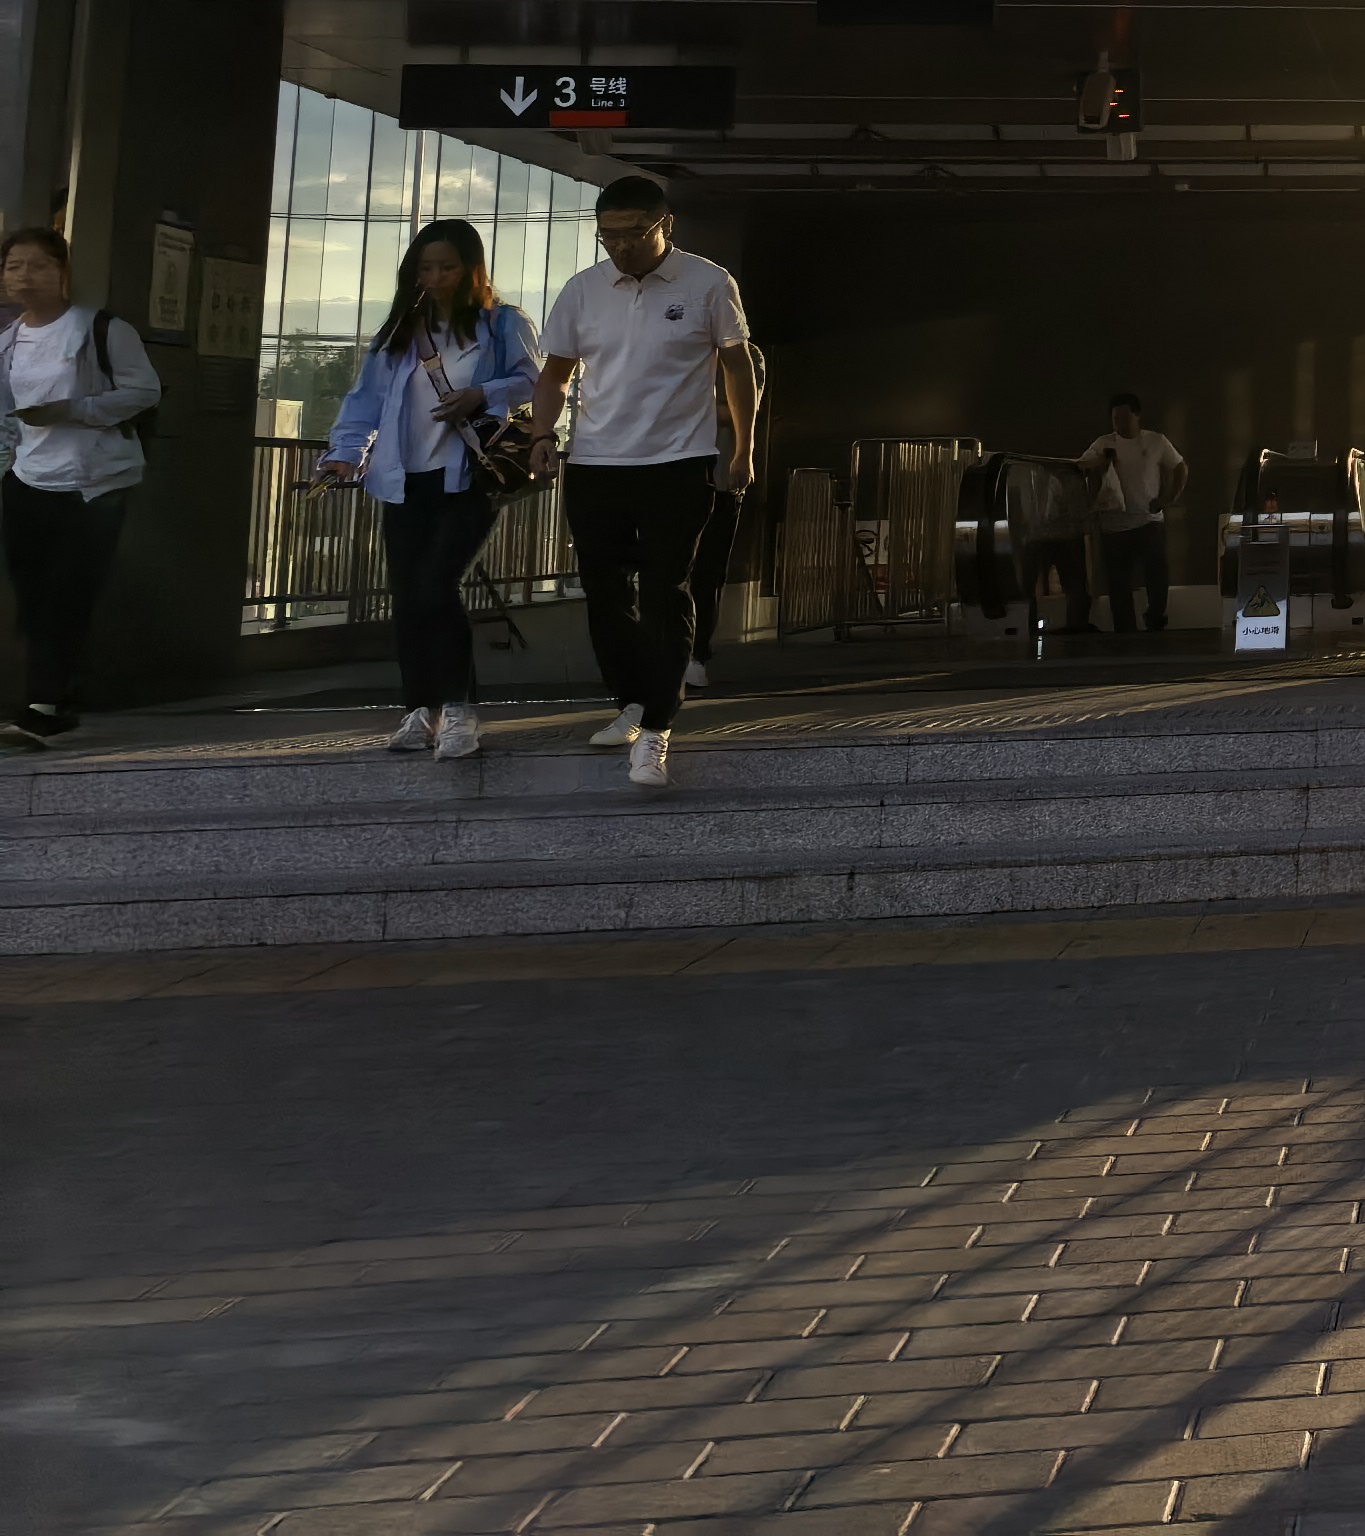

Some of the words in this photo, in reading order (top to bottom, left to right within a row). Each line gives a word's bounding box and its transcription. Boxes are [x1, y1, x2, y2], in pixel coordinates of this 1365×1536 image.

[554, 76, 577, 108] 3
[589, 76, 627, 95] 号线
[591, 98, 614, 107] Line
[1242, 625, 1280, 636] 小心地滑
